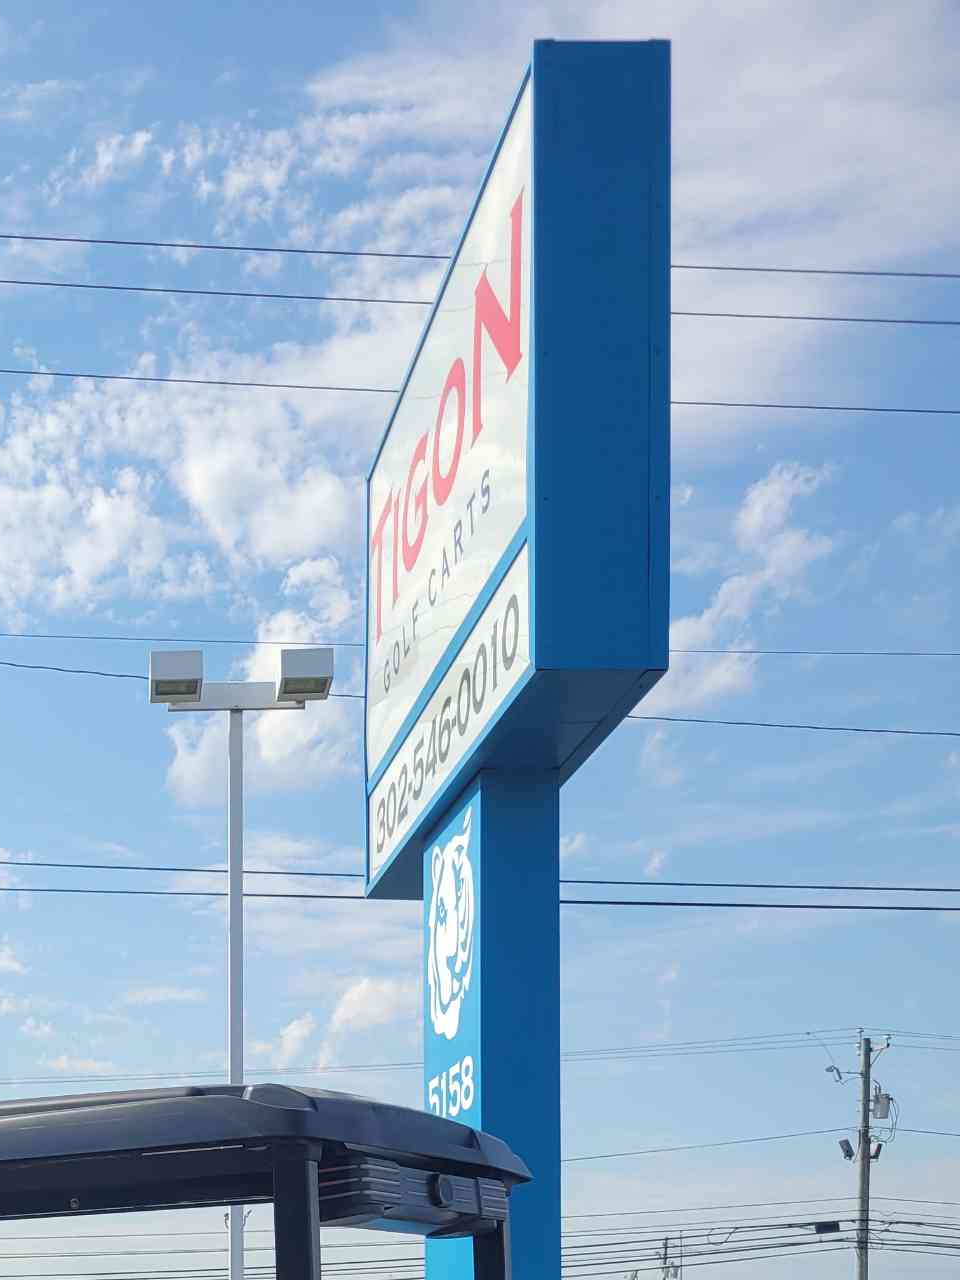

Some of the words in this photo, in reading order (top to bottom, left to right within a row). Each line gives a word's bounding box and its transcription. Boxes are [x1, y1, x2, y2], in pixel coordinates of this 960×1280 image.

[372, 186, 524, 646] TIGON
[382, 600, 419, 693] GOLF
[427, 469, 490, 607] CARTS
[376, 594, 520, 854] 302-546-0010
[428, 1055, 474, 1118] 5158
